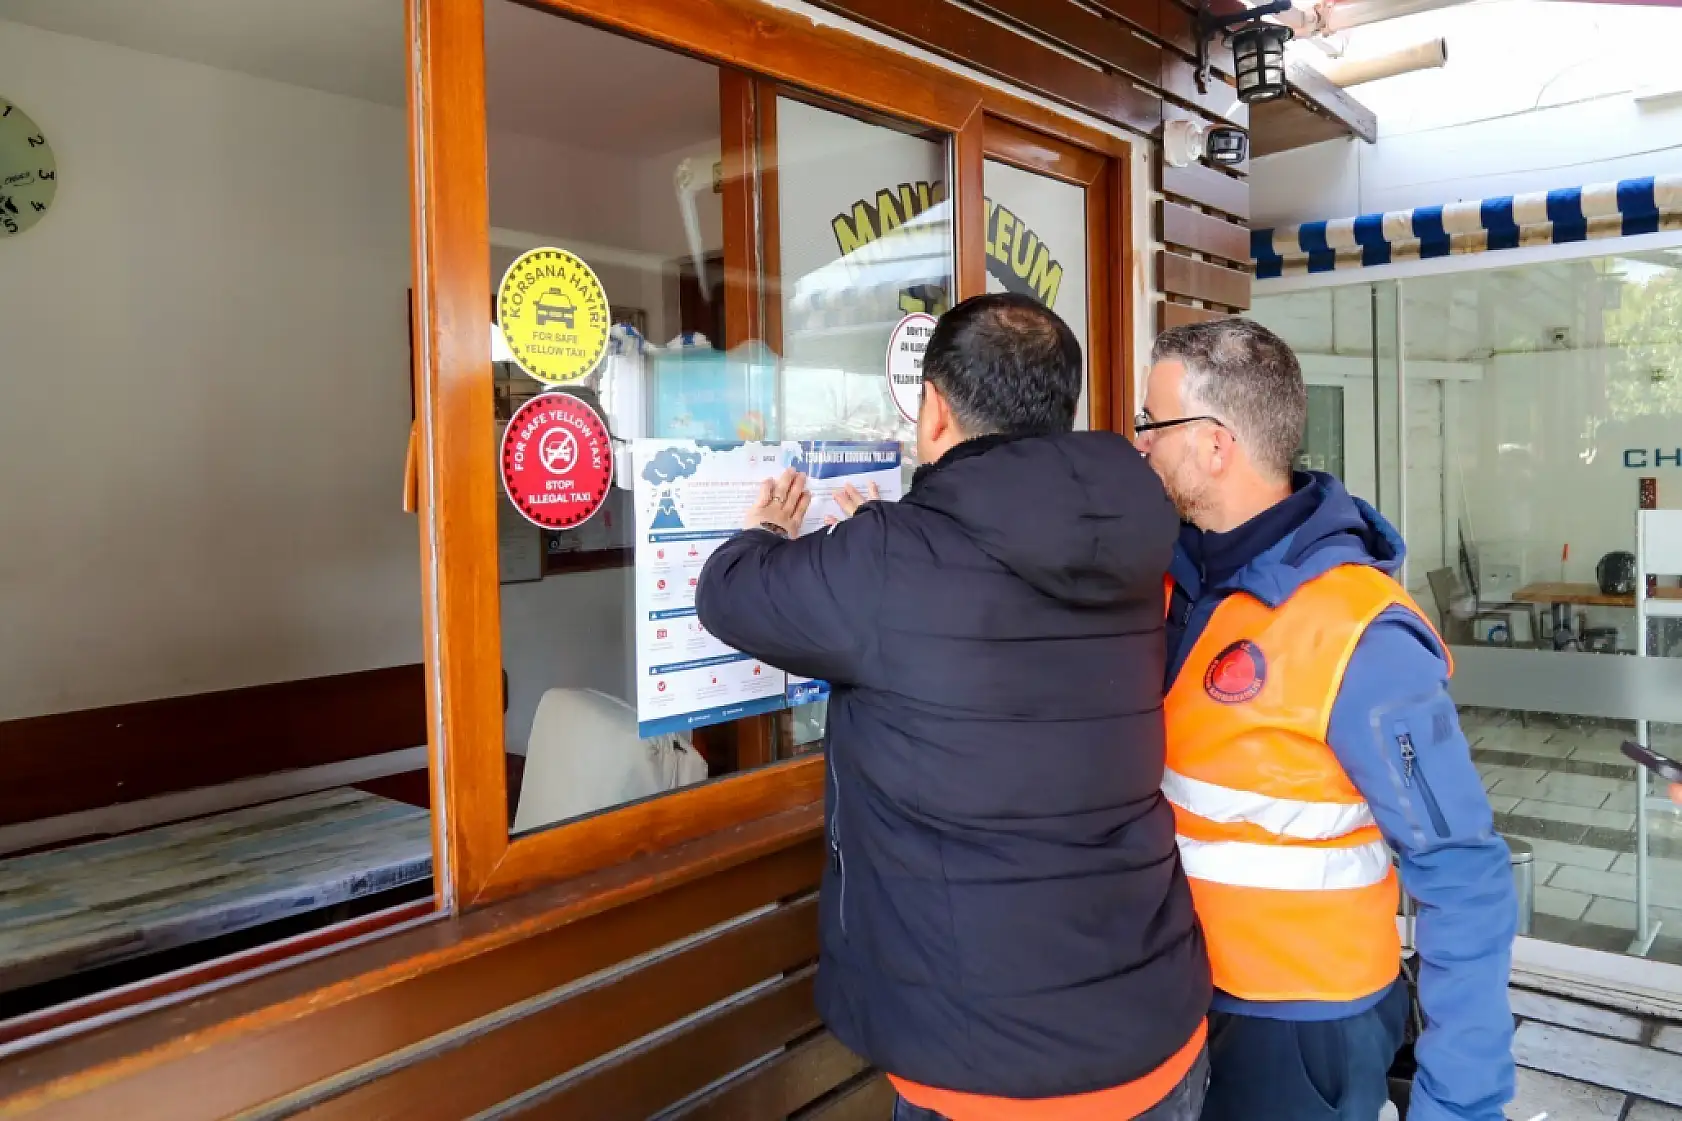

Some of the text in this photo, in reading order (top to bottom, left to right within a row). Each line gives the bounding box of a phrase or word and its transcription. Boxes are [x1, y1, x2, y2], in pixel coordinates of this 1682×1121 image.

[3, 106, 13, 117] 1
[28, 133, 44, 147] 2
[38, 168, 55, 181] 3
[31, 200, 46, 211] 4
[4, 218, 19, 233] 5
[510, 264, 567, 318] KORSANA
[532, 331, 578, 345] FOR SAFE
[525, 344, 586, 358] YELLOW TAXI
[514, 409, 601, 472] FOR SAFE YELLOW TAXI
[545, 480, 575, 490] STOP!
[528, 492, 591, 504] ILLEGAL TAXI
